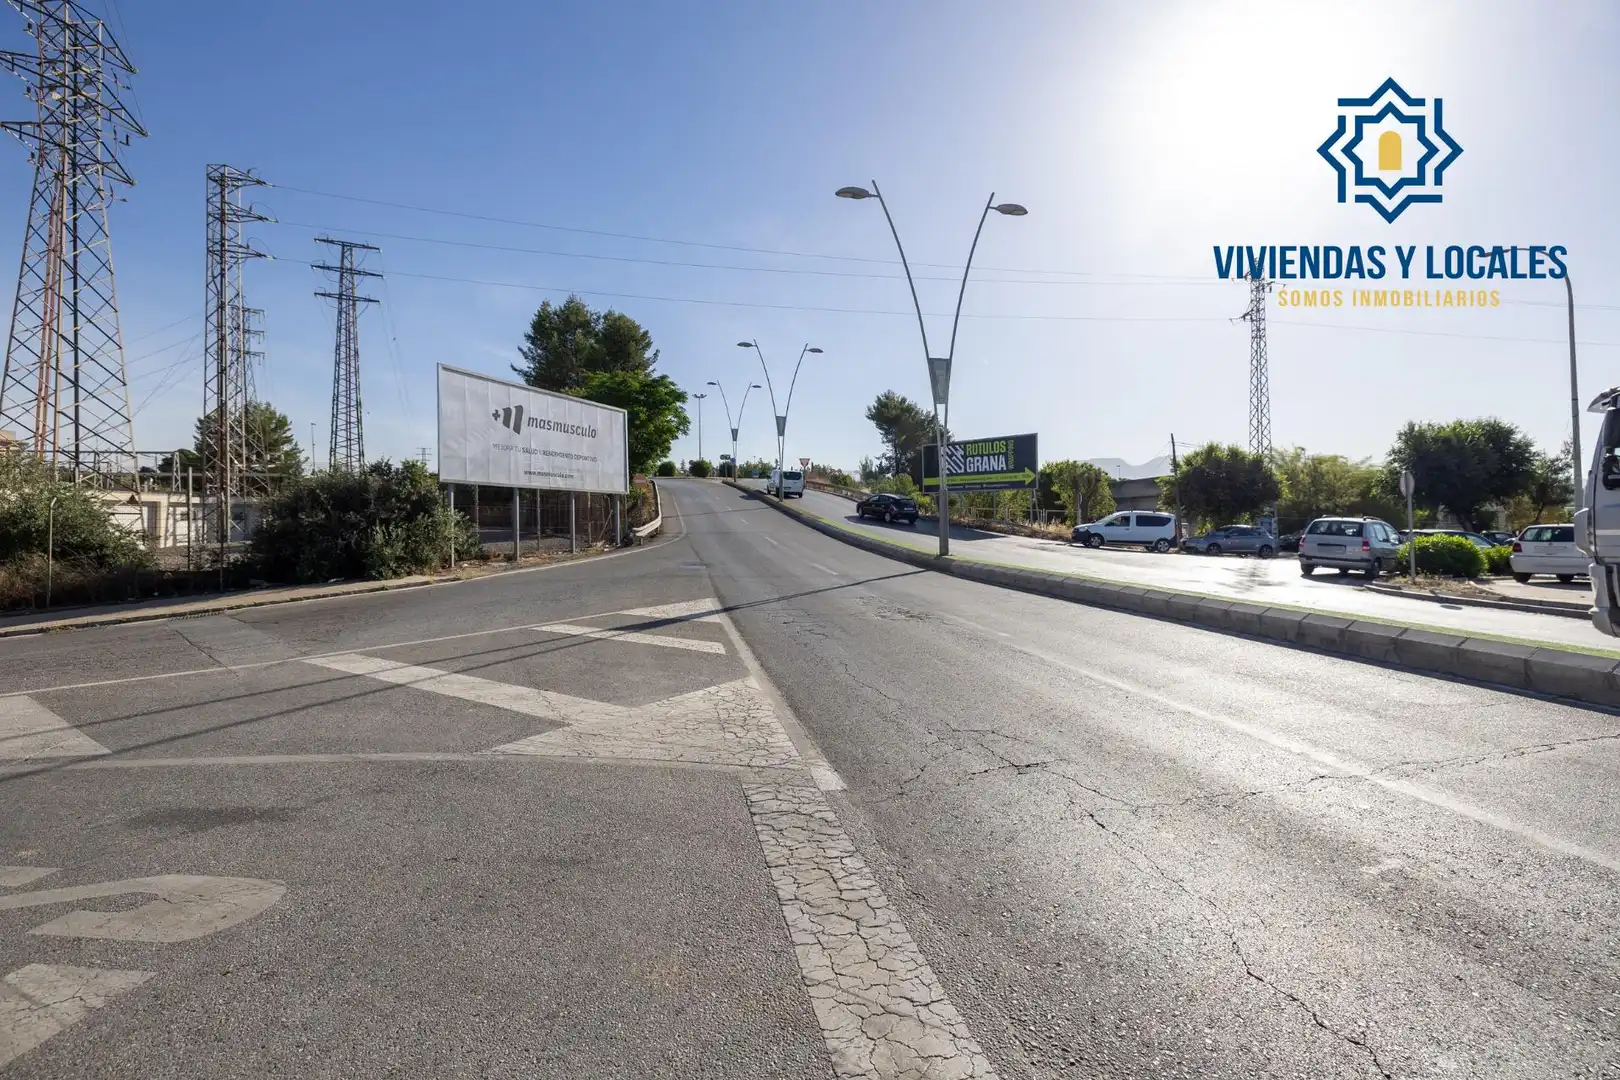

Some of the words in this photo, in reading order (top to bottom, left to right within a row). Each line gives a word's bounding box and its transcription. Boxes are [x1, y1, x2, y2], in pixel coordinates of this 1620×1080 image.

[527, 416, 596, 438] masmusculo
[966, 441, 1006, 455] ROTULOS
[966, 455, 1006, 472] GRANA
